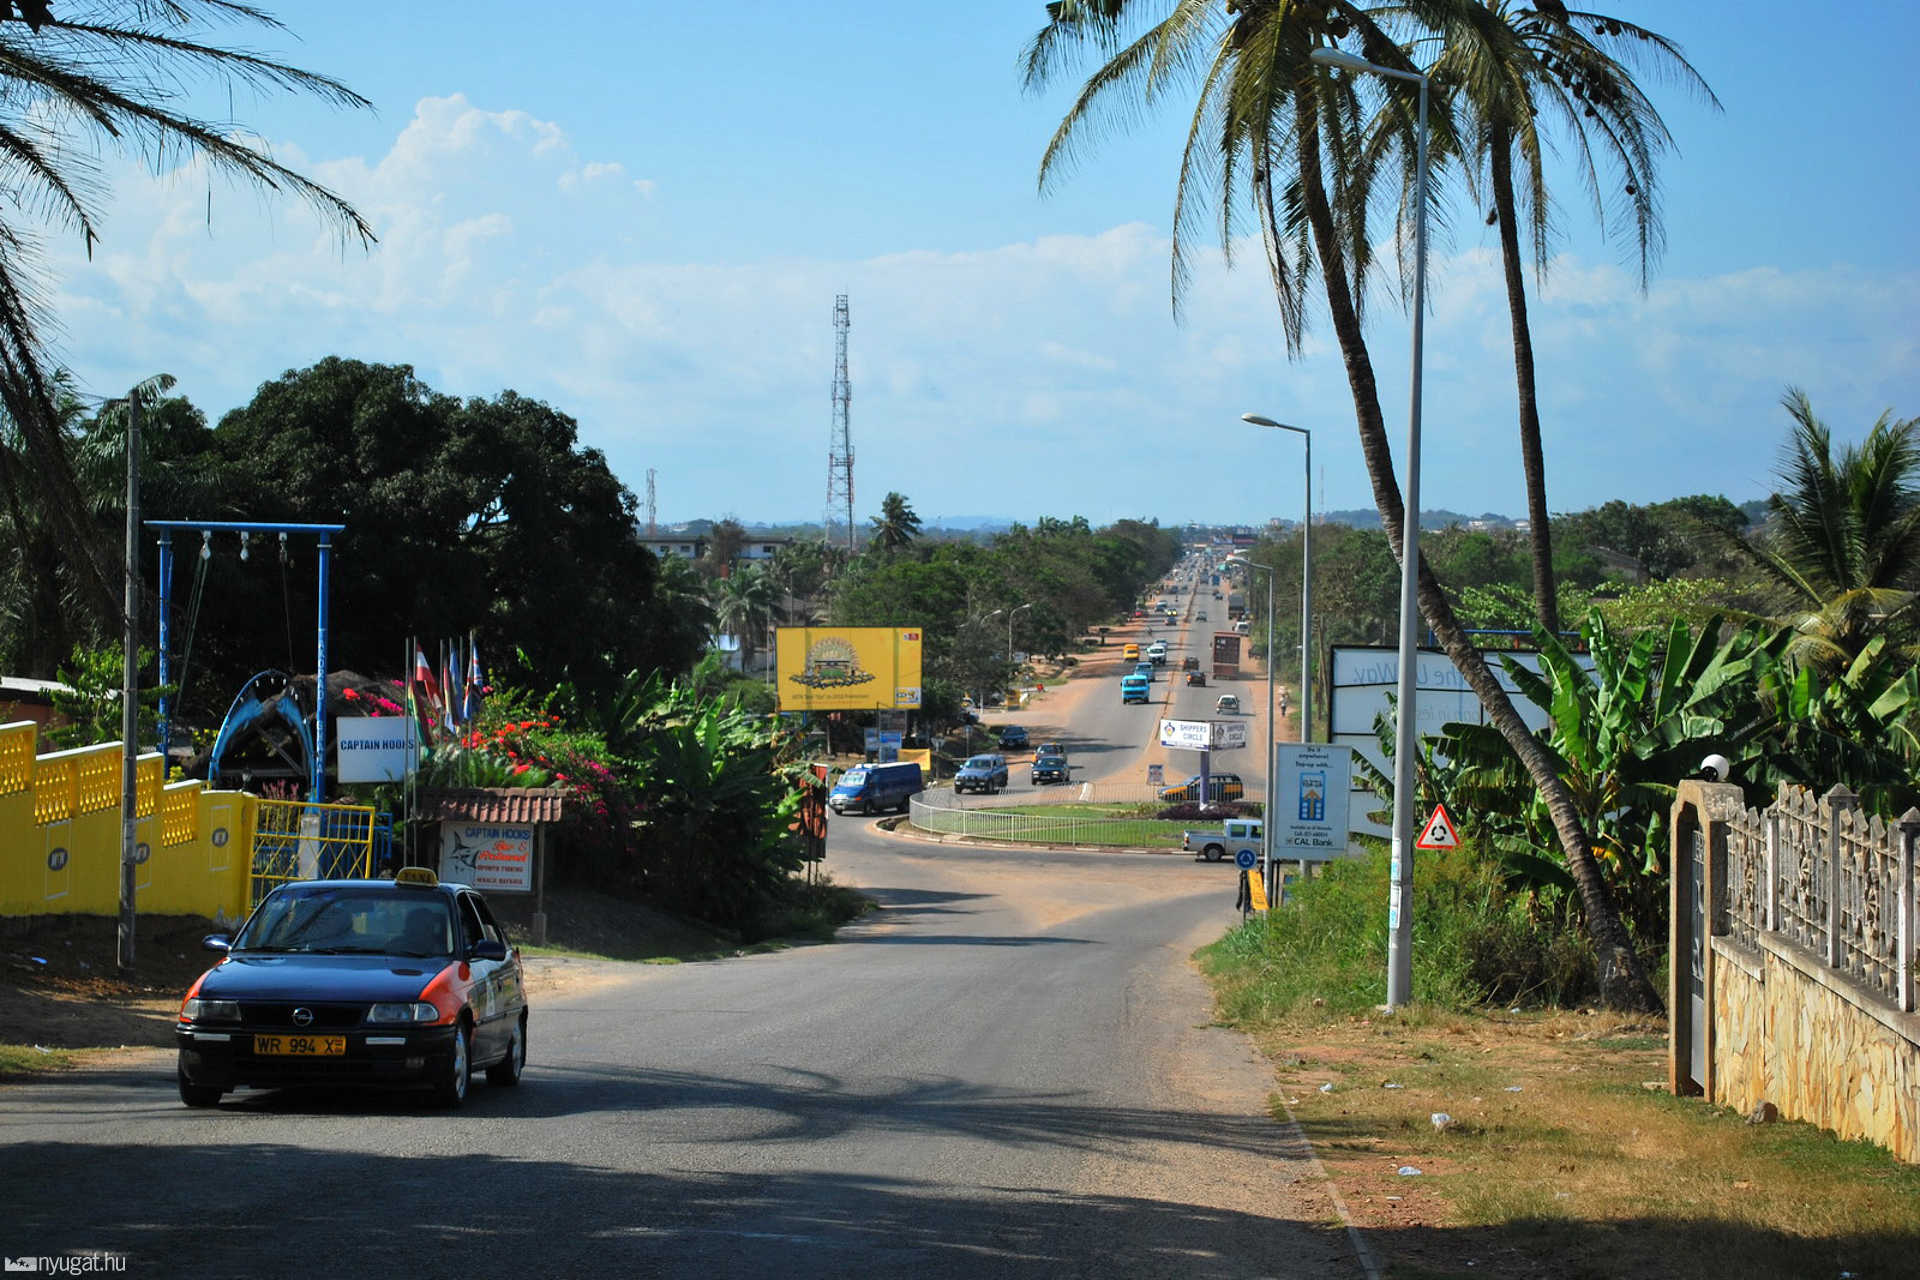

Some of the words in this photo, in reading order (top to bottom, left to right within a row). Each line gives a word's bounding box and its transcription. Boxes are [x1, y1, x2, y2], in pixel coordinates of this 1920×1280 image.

[1180, 724, 1207, 734] SHIPPERS
[1183, 733, 1203, 741] CIRCLE
[341, 739, 379, 750] CAPTAIN
[465, 827, 499, 838] CAPTAIN
[502, 829, 530, 840] HOOKS
[1294, 838, 1310, 846] CAL
[1312, 838, 1333, 847] Bank
[257, 1038, 281, 1053] WR
[289, 1038, 315, 1053] 994
